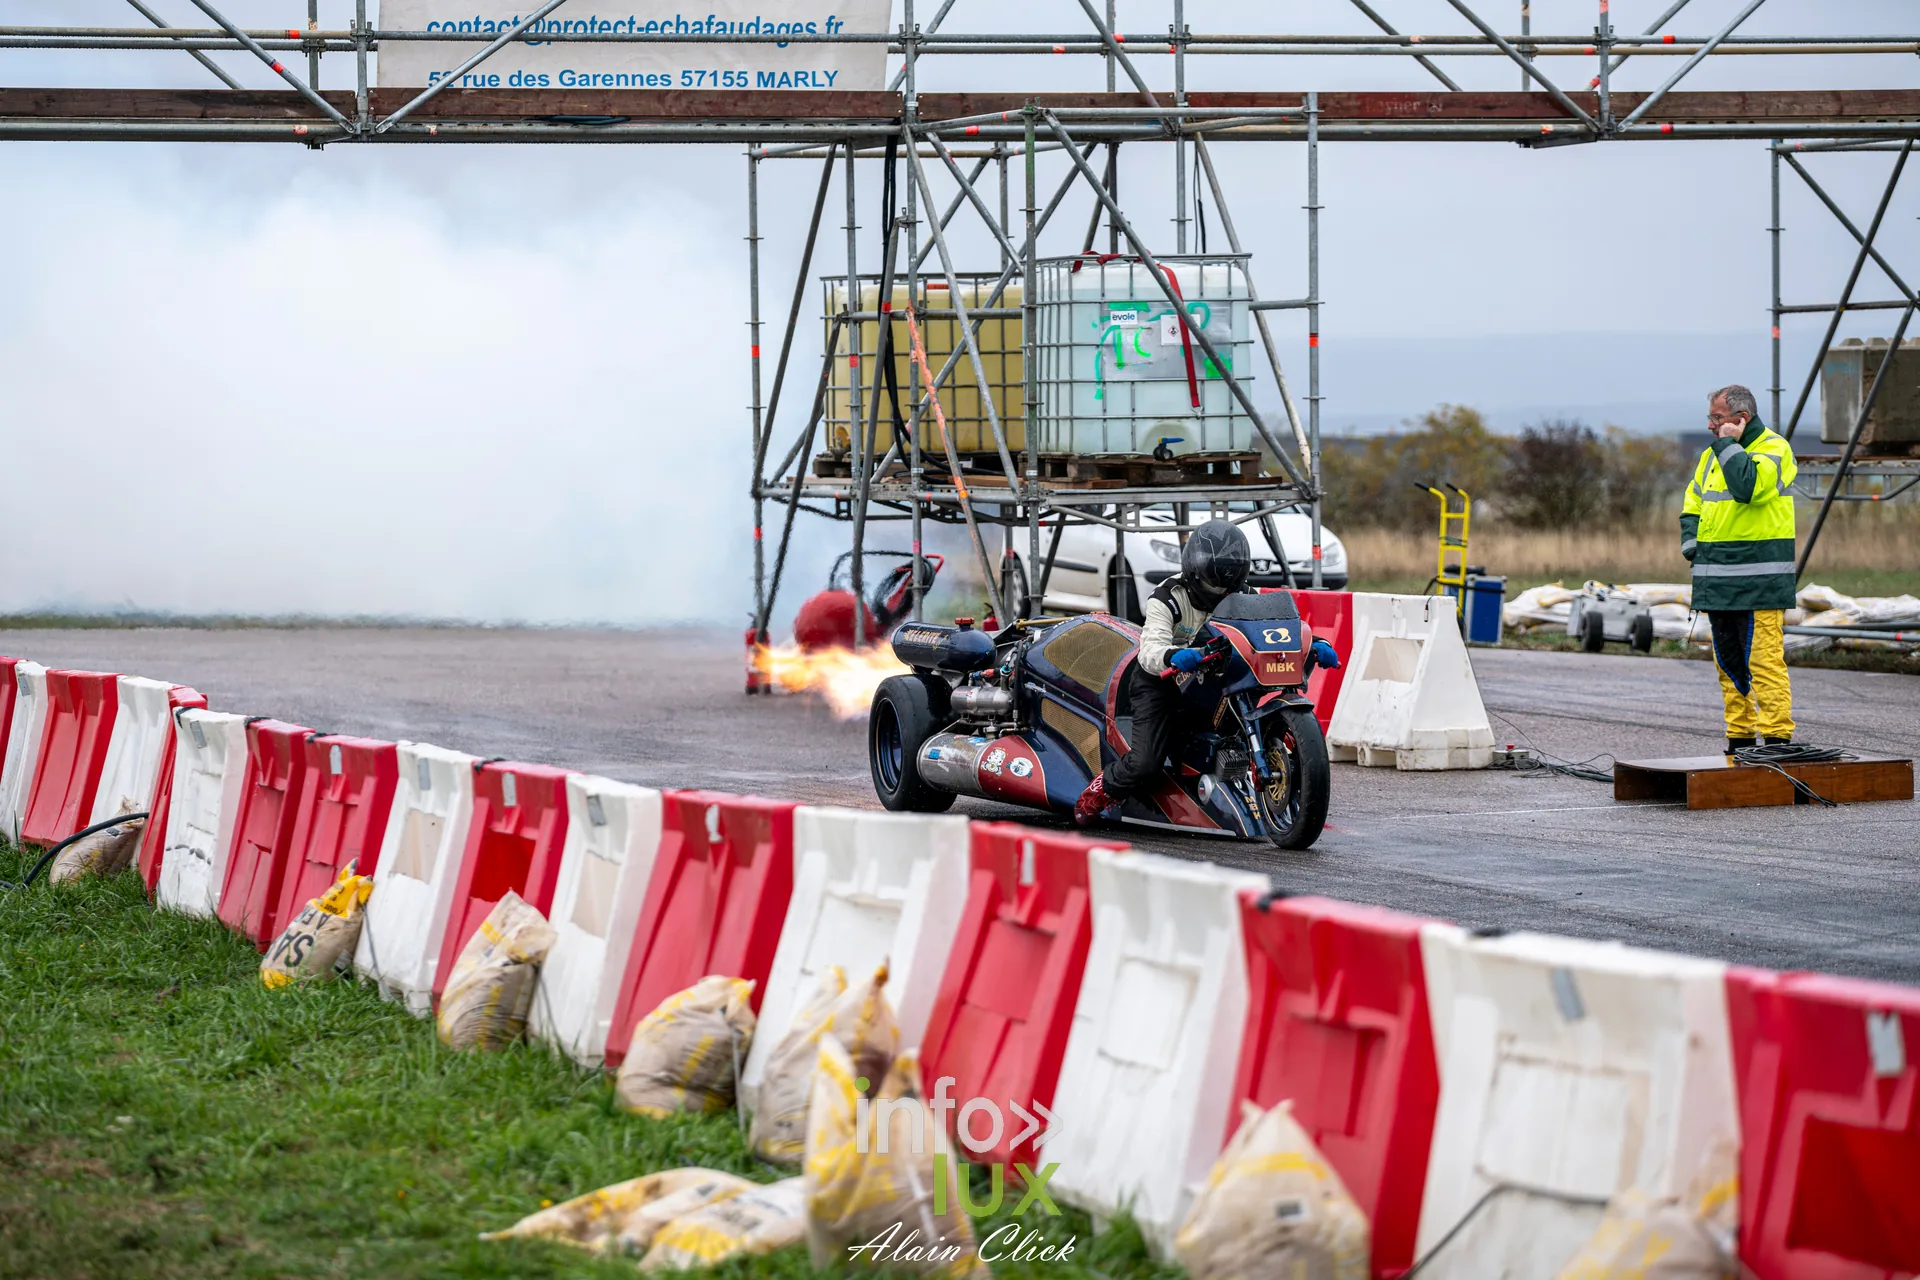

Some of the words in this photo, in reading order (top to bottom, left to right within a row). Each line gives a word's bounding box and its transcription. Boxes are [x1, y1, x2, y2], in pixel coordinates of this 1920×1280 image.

[462, 73, 501, 87] rue
[508, 70, 550, 87] des
[558, 69, 672, 87] Garennes
[680, 70, 749, 87] 57155
[756, 70, 839, 88] MARLY
[1266, 661, 1296, 673] MBK
